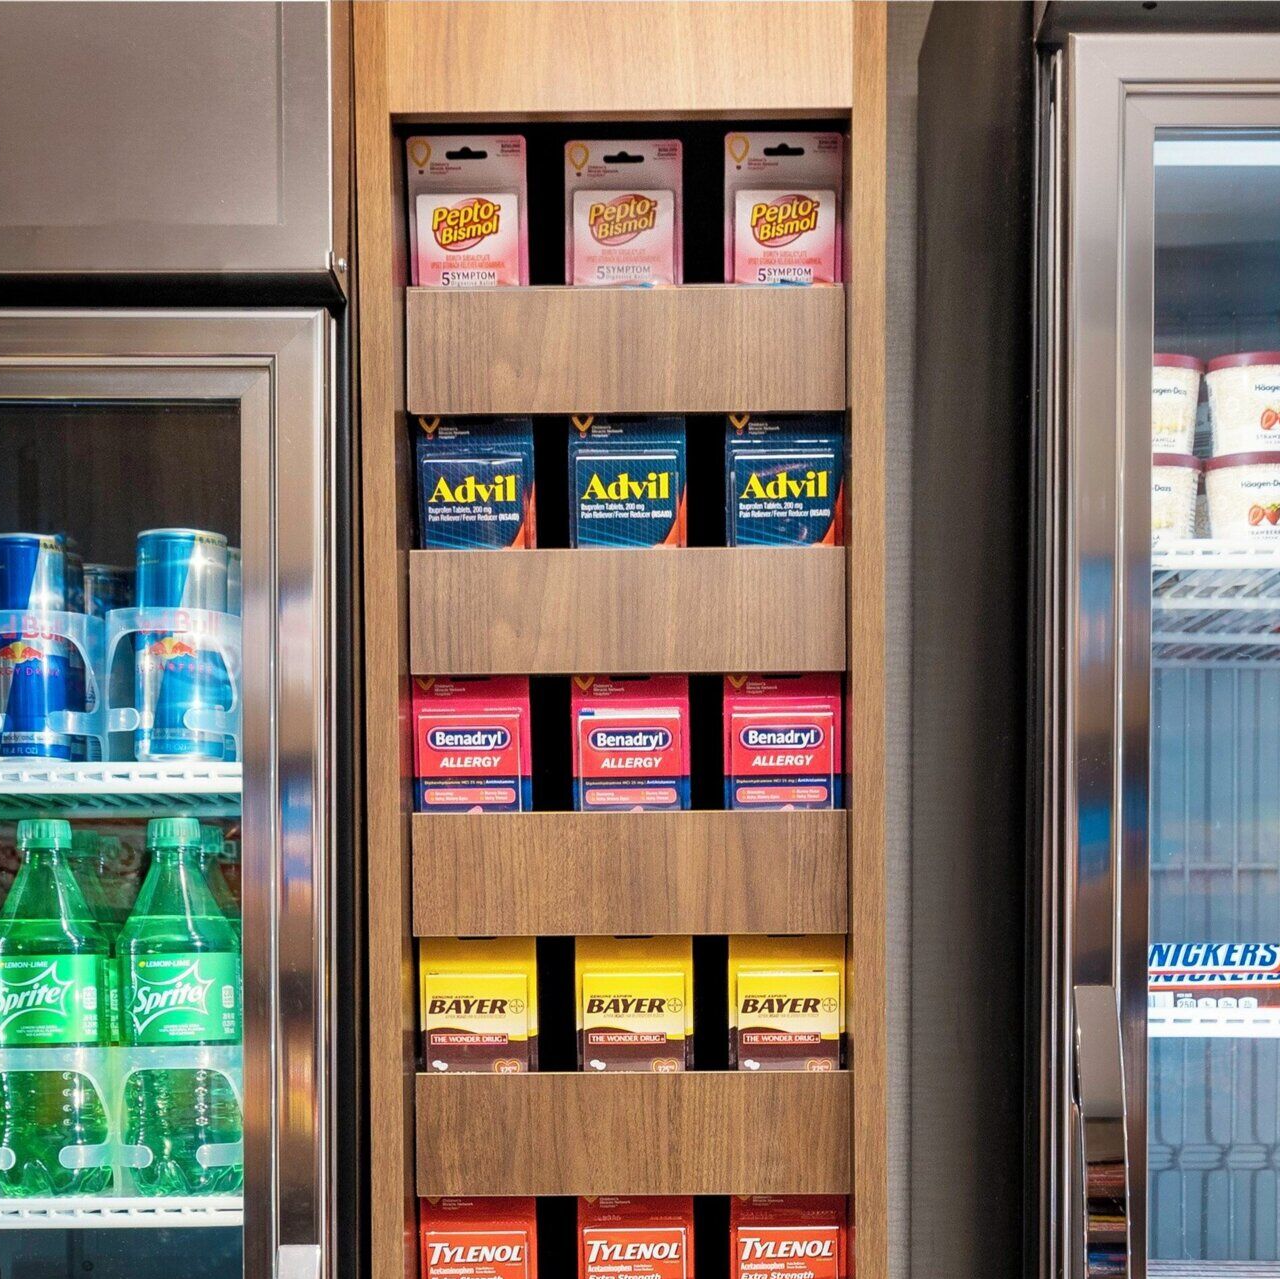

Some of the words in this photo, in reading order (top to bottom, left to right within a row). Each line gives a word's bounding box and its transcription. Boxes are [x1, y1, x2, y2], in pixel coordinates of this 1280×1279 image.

[432, 203, 501, 228] Pepto-
[589, 199, 657, 225] Pepto-
[750, 199, 820, 226] Pepto-
[441, 217, 499, 245] Bismol
[597, 212, 655, 240] Bismol
[759, 214, 817, 242] Bismol
[451, 272, 496, 281] SYMPTOM
[606, 266, 650, 275] SYMPTOM
[767, 268, 811, 277] SYMPTOM
[429, 475, 516, 503] Advil
[581, 472, 669, 500] Advil
[739, 471, 827, 500] Advil
[435, 732, 502, 749] Benadryl
[597, 732, 663, 749] Benadryl
[748, 730, 814, 748] Benadryl
[440, 757, 501, 768] ALLERGY
[601, 757, 662, 768] ALLERGY
[752, 755, 813, 766] ALLERGY
[4, 961, 48, 969] LEMON-LIME
[135, 984, 203, 1014] Sprite
[429, 999, 508, 1014] BAYER
[587, 999, 666, 1013] BAYER
[741, 998, 821, 1013] BAYER
[429, 1243, 522, 1265] TYLENOL
[587, 1240, 680, 1263] TYLENOL
[740, 1238, 833, 1260] TYLENOL
